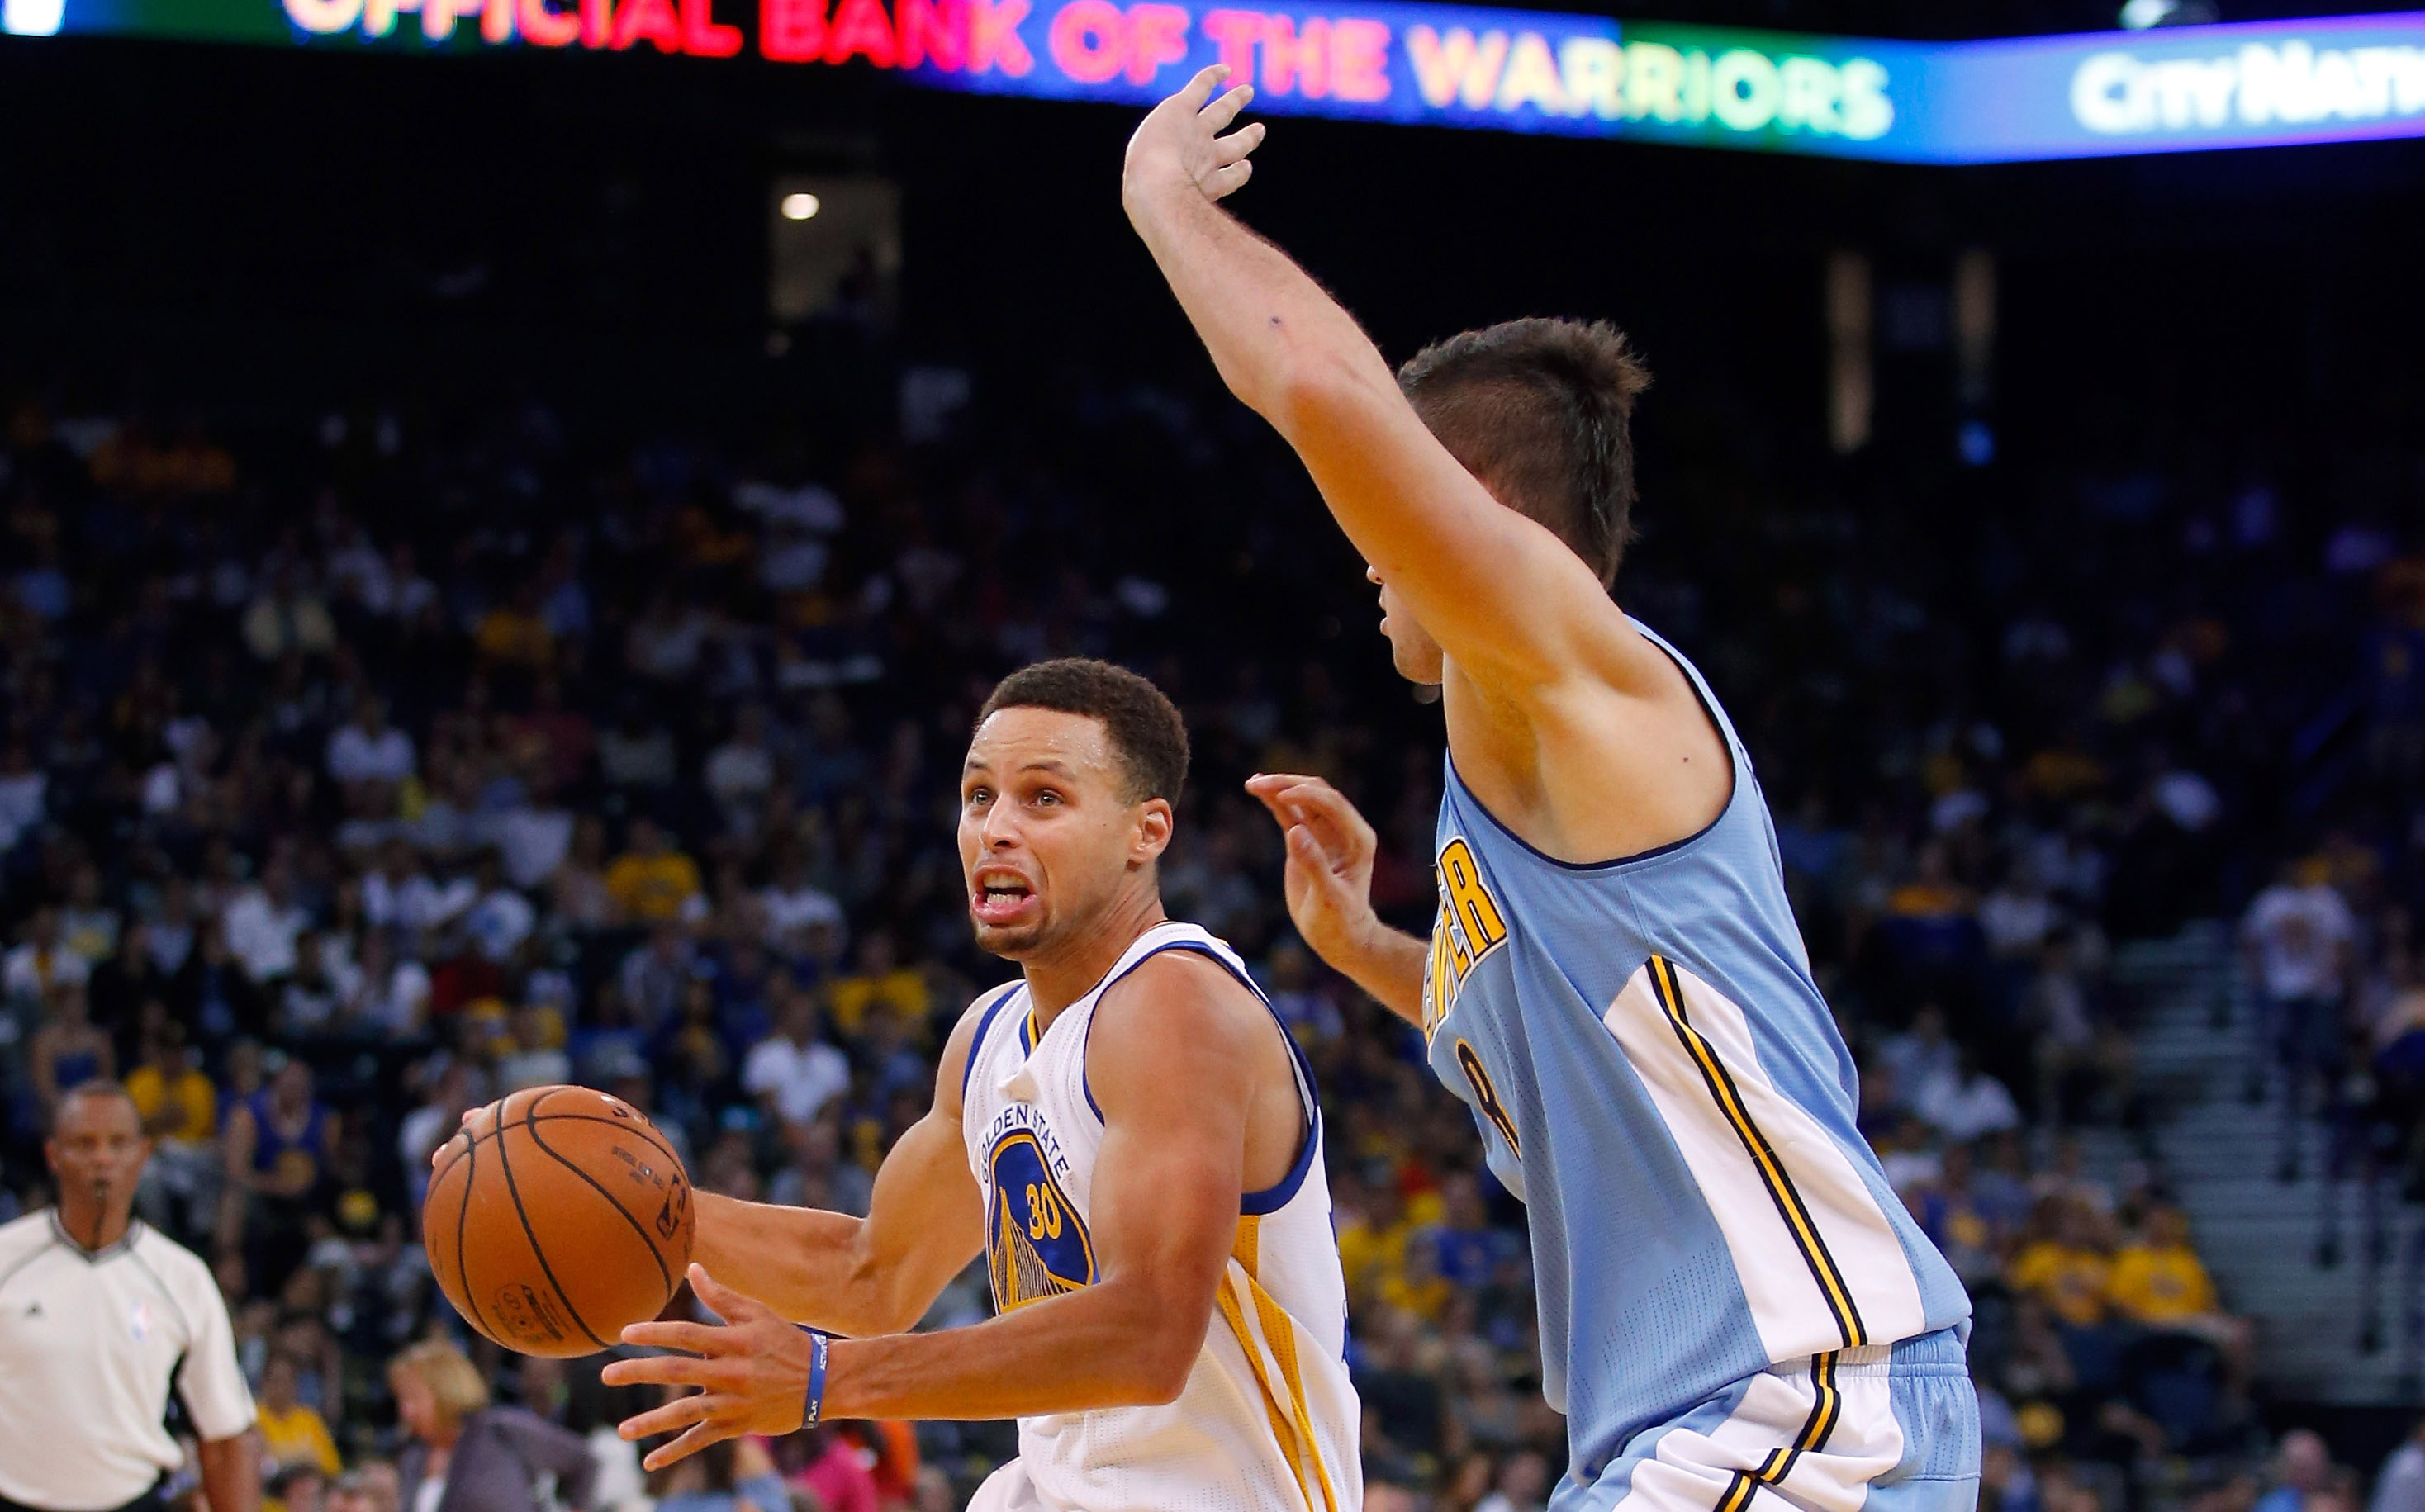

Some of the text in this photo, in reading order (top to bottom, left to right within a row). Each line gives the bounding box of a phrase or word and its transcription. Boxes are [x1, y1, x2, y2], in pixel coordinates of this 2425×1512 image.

[759, 0, 1034, 77] BANK
[1049, 2, 1189, 83] OF
[1203, 10, 1392, 102] THE
[1407, 24, 1895, 140] WARRIORS
[981, 1105, 1069, 1183] GOLDEN STATE
[1027, 1183, 1061, 1239] 30
